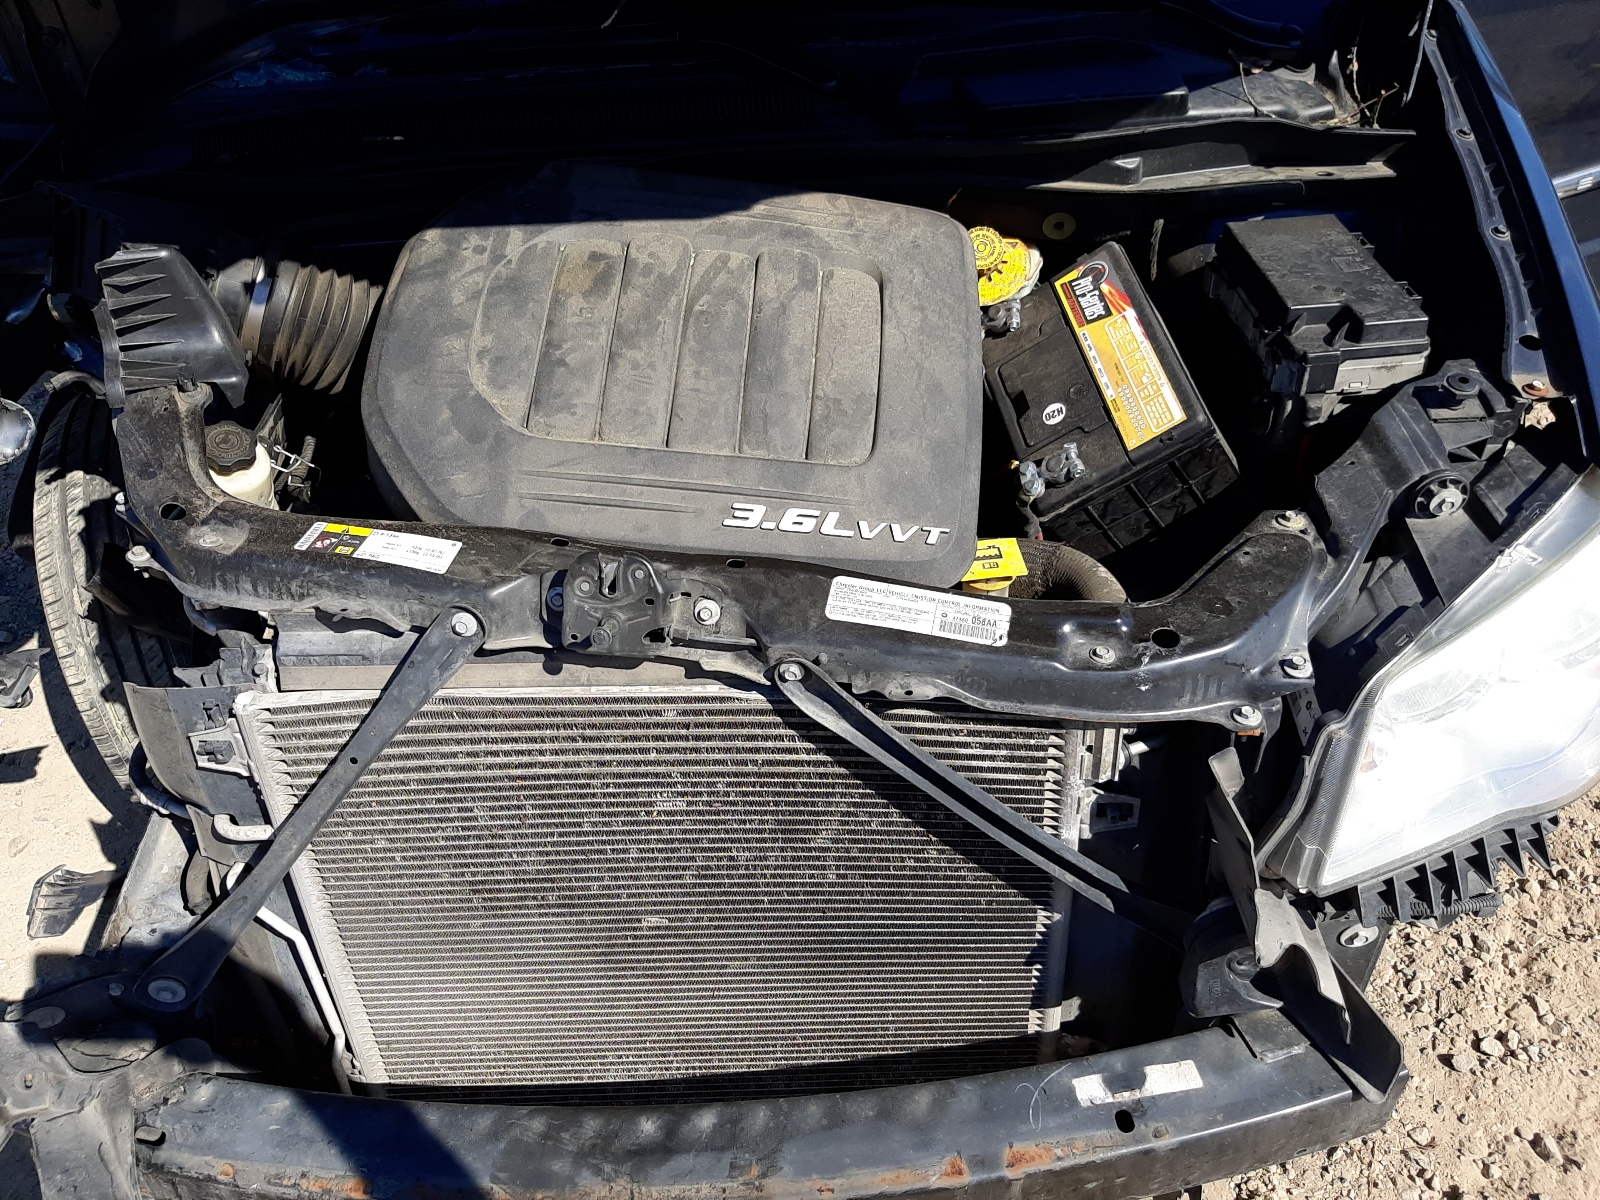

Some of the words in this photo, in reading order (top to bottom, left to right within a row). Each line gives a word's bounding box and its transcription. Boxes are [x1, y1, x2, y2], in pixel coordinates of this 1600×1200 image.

[937, 598, 961, 607] CONTROL
[962, 602, 1000, 613] INFORMATION
[970, 616, 998, 628] 058AA
